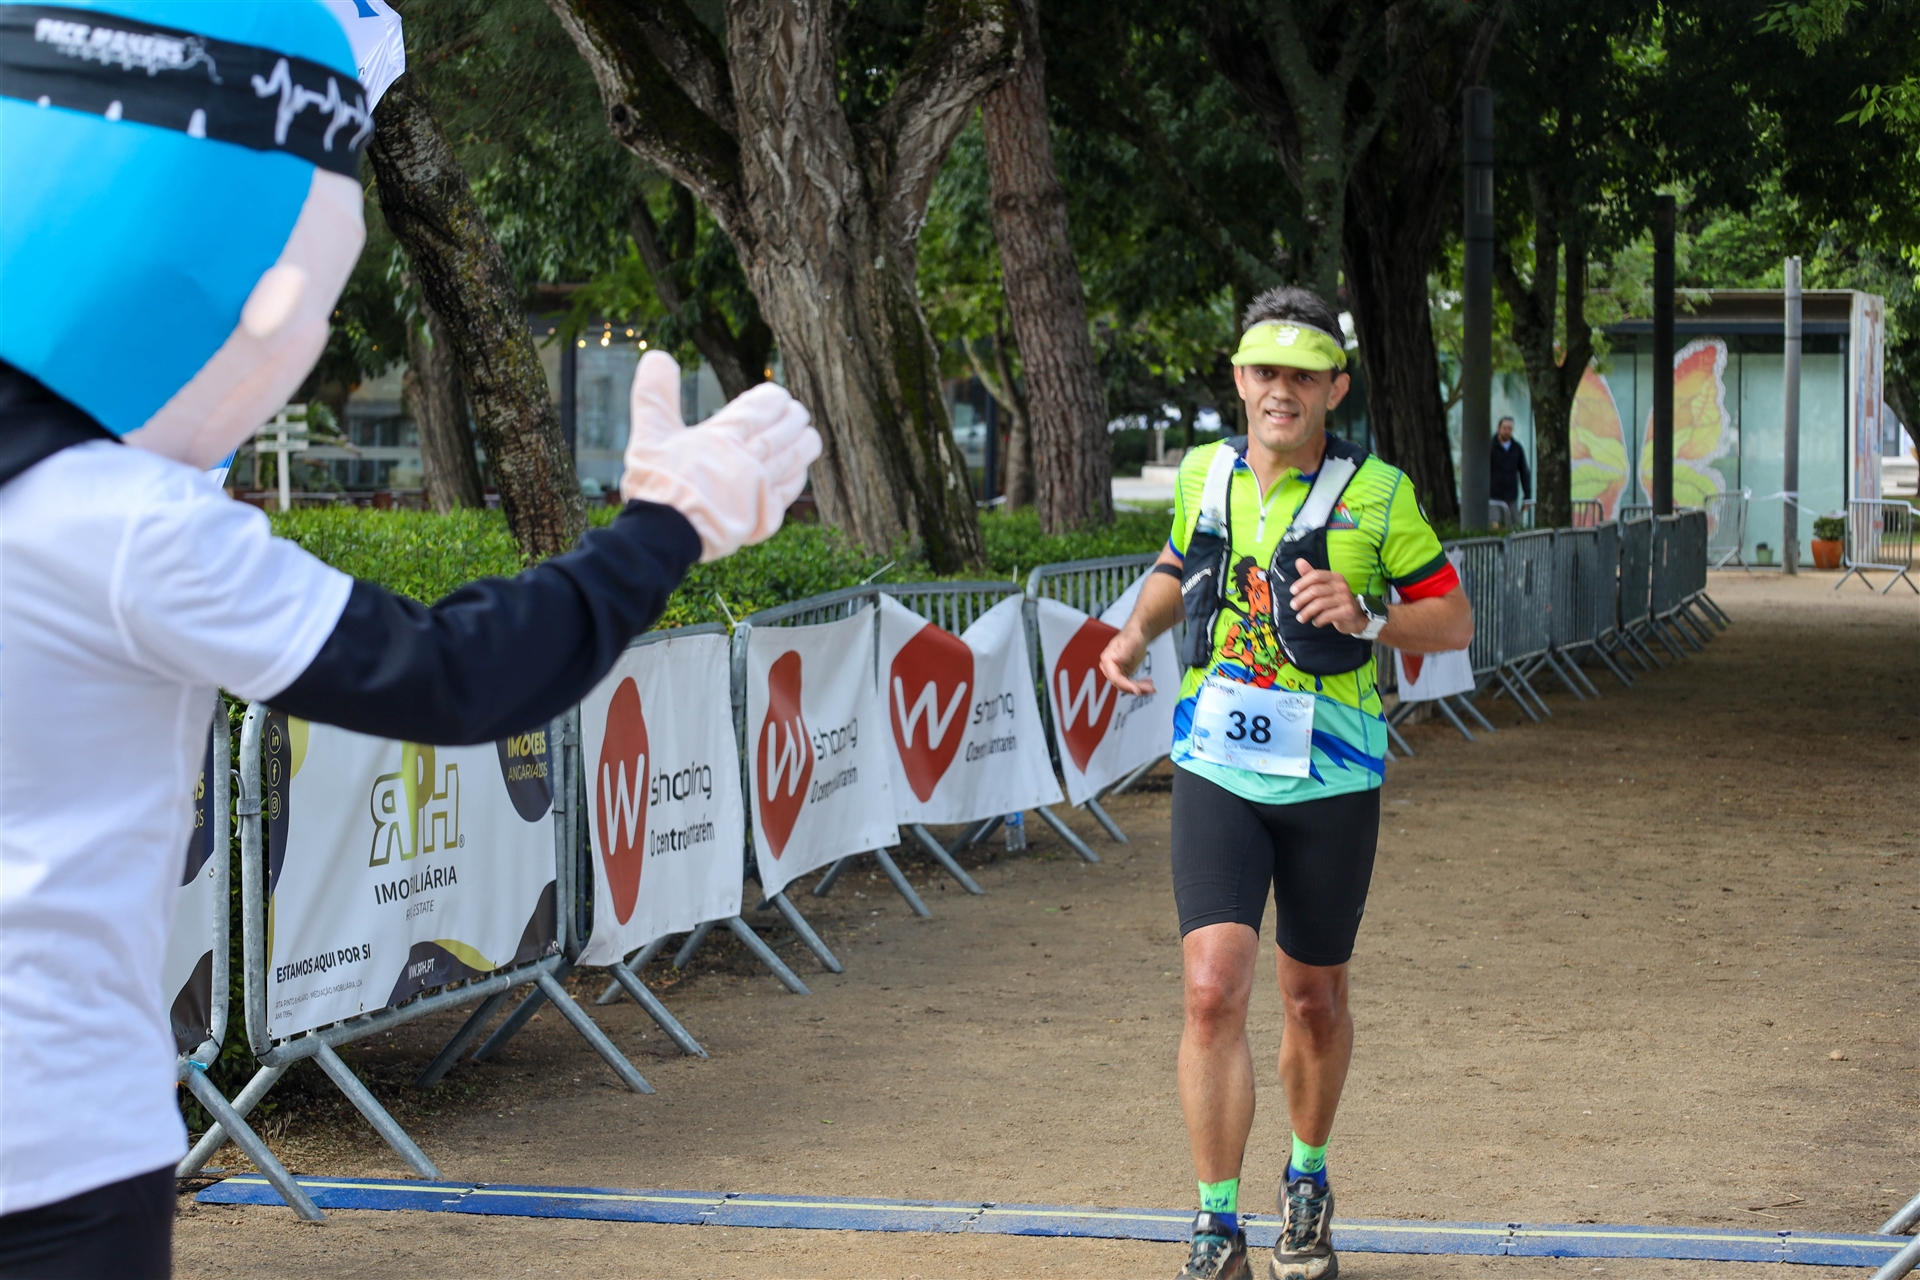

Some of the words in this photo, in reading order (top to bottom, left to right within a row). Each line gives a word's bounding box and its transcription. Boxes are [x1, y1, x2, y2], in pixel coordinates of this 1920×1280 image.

[893, 676, 967, 750] W
[1226, 711, 1271, 744] 38
[767, 715, 807, 803] W
[603, 753, 645, 856] W
[374, 864, 458, 905] IMOBILIÁRIA
[276, 957, 313, 984] ESTAMOS
[313, 951, 337, 973] AQUI
[338, 947, 361, 966] POR
[361, 943, 371, 959] SI
